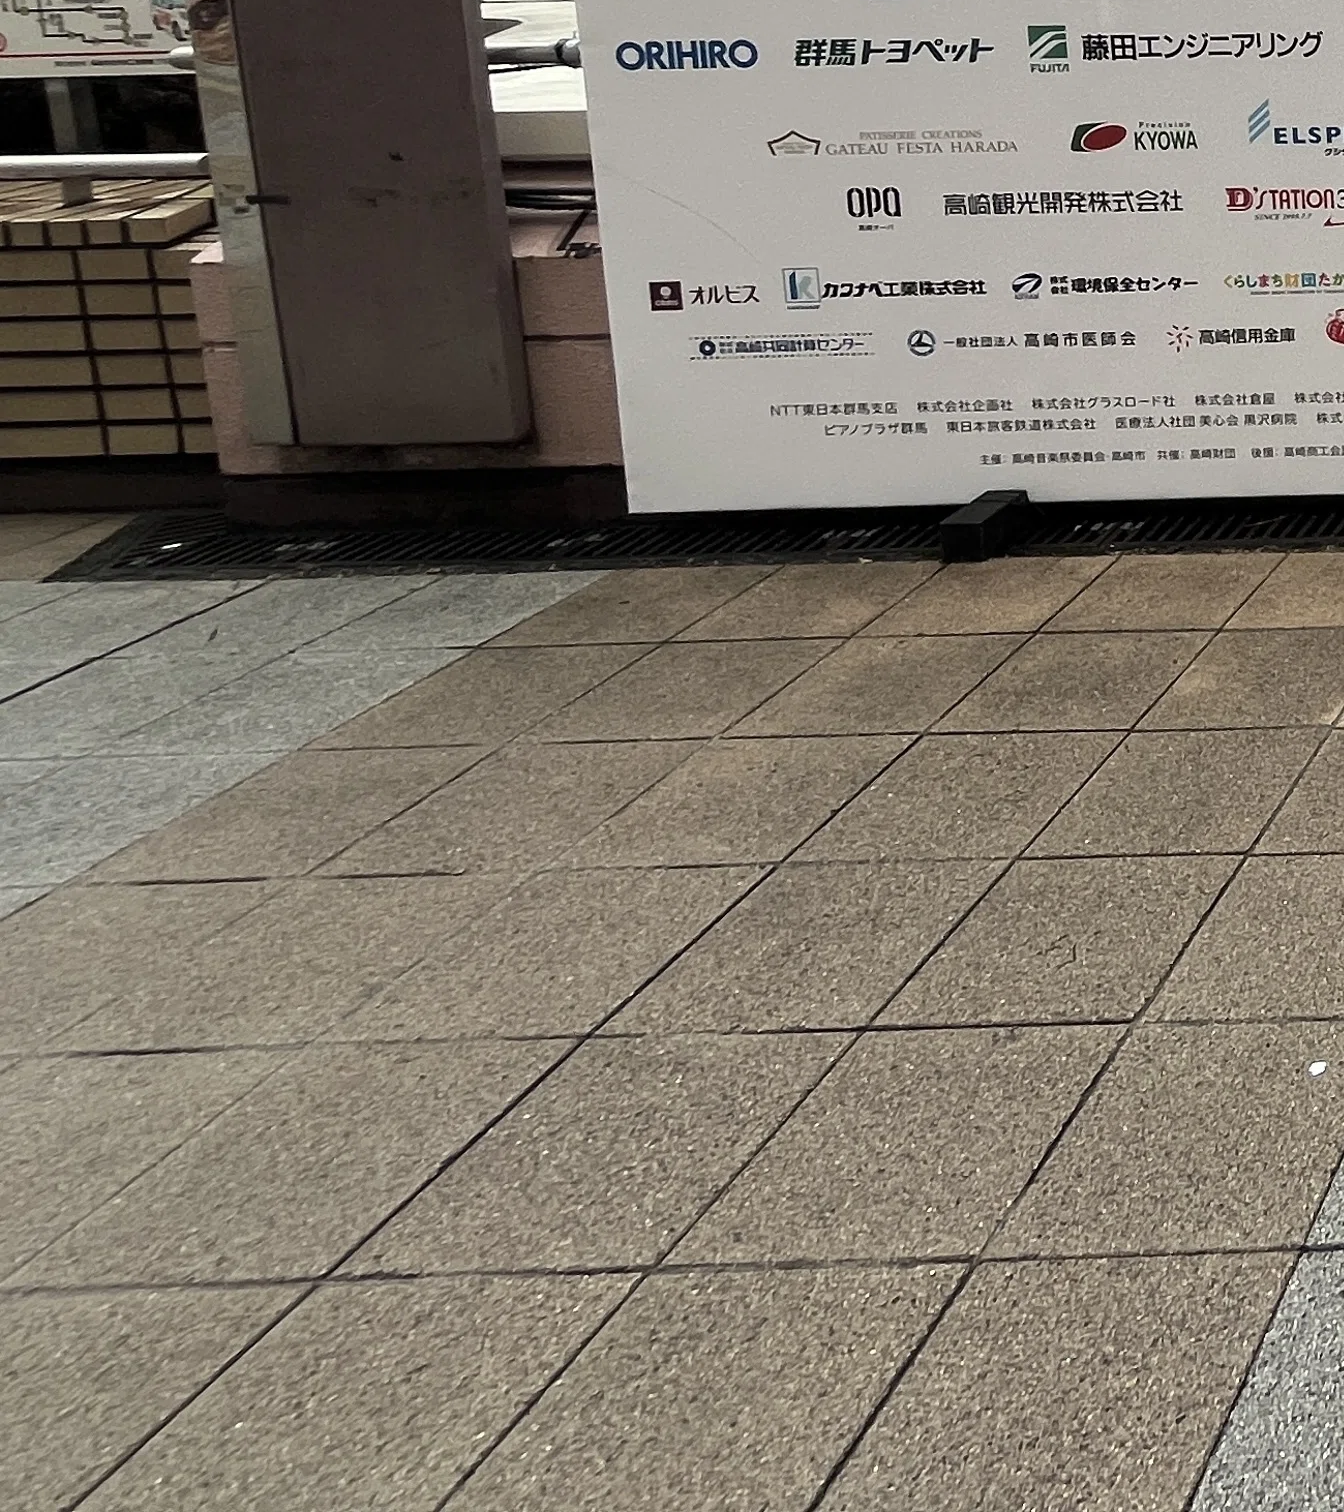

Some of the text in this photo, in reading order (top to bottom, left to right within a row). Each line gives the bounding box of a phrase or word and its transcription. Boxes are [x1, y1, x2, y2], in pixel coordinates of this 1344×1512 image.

[616, 40, 758, 70] ORIHIRO
[794, 38, 994, 66] 群馬トヨペット
[1081, 31, 1323, 61] 藤田エンジニアリング
[894, 138, 946, 154] FESTA
[948, 137, 1018, 153] HARADA
[1134, 130, 1198, 151] KYOWA
[943, 189, 1183, 216] 高崎観光開発株式会社
[689, 285, 760, 305] オルビス
[1071, 276, 1198, 293] 環境保全センター
[1198, 328, 1295, 344] 高崎信用金庫
